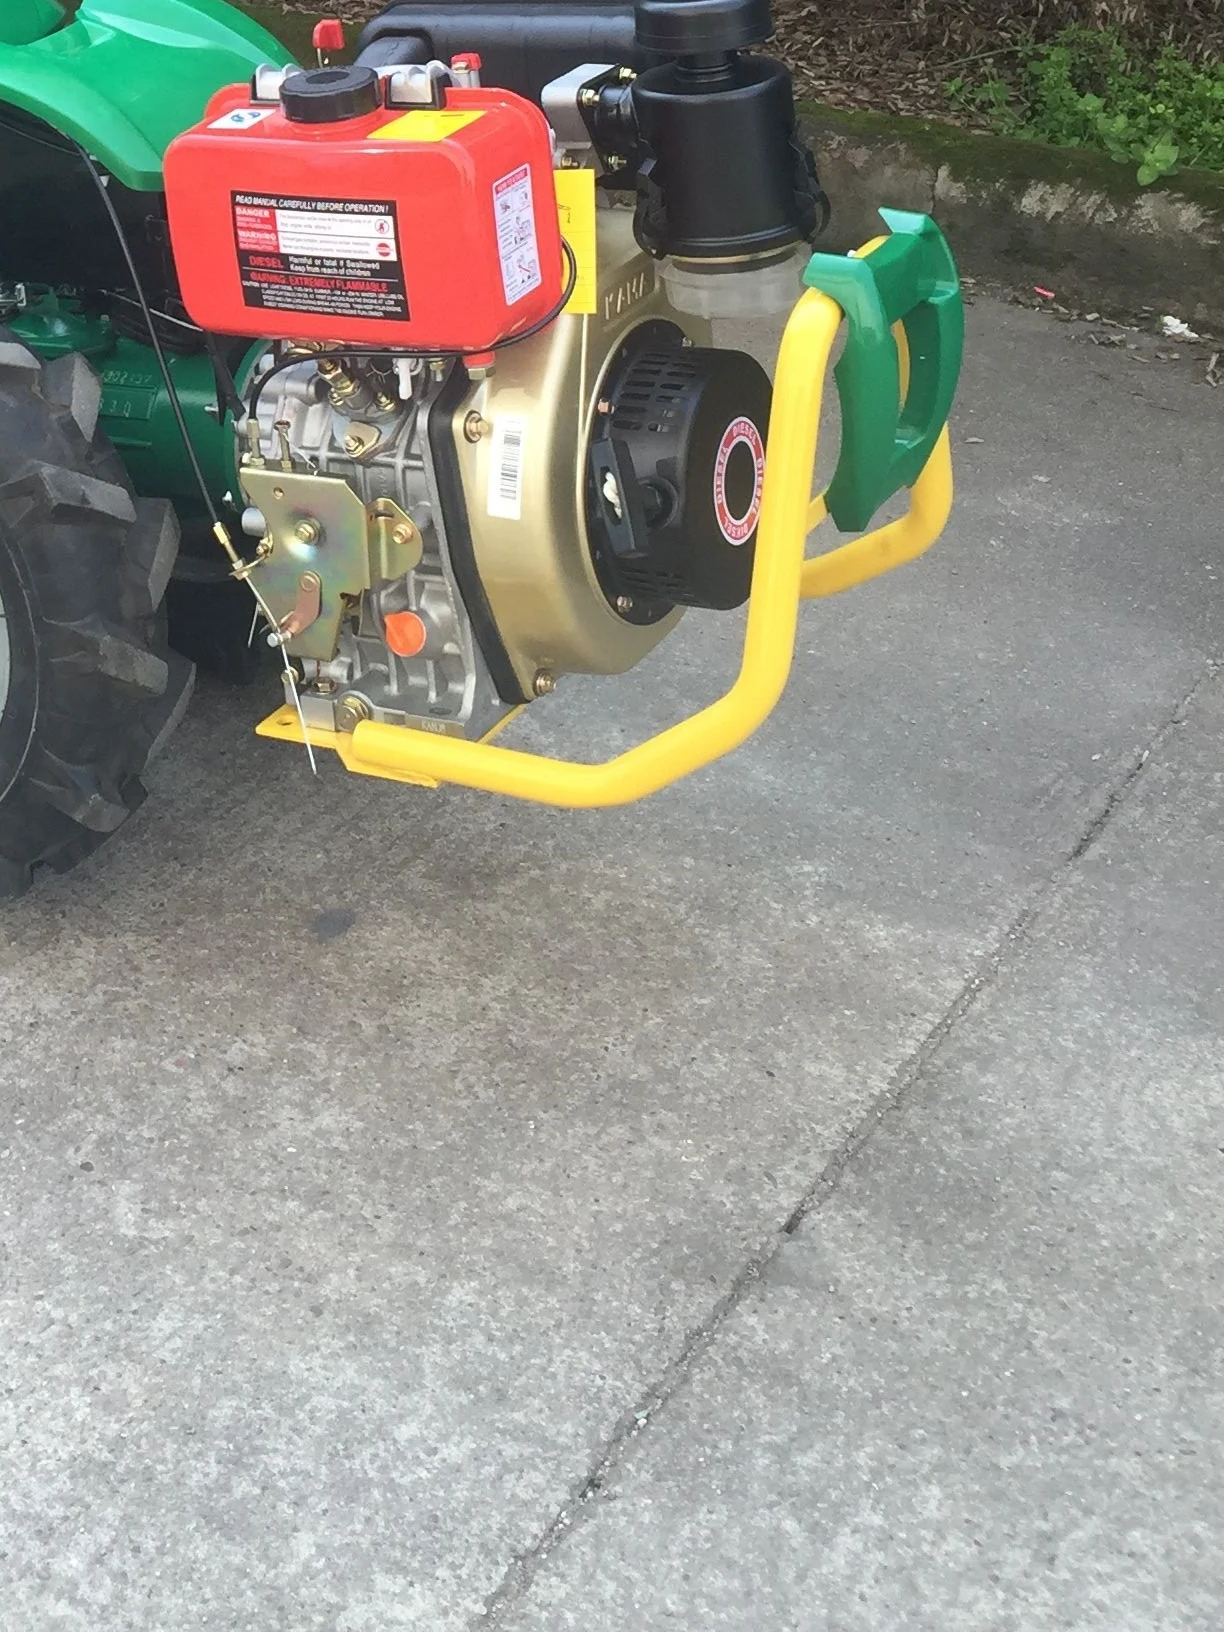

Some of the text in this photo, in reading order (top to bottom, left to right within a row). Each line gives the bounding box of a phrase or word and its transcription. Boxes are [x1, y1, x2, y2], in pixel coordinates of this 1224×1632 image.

[235, 195, 252, 204] READ
[252, 196, 278, 207] MANUAL
[278, 198, 316, 210] CAREFULLY
[316, 201, 344, 212] BEFORE
[344, 202, 385, 213] OPERATION
[235, 208, 270, 217] DANGER
[238, 230, 277, 240] WARNING
[249, 255, 284, 268] DIESEL
[289, 276, 335, 288] EXTREMELY
[336, 280, 388, 292] FLAMMABLE
[732, 422, 757, 445] DIESEL
[723, 516, 749, 539] DIESEL
